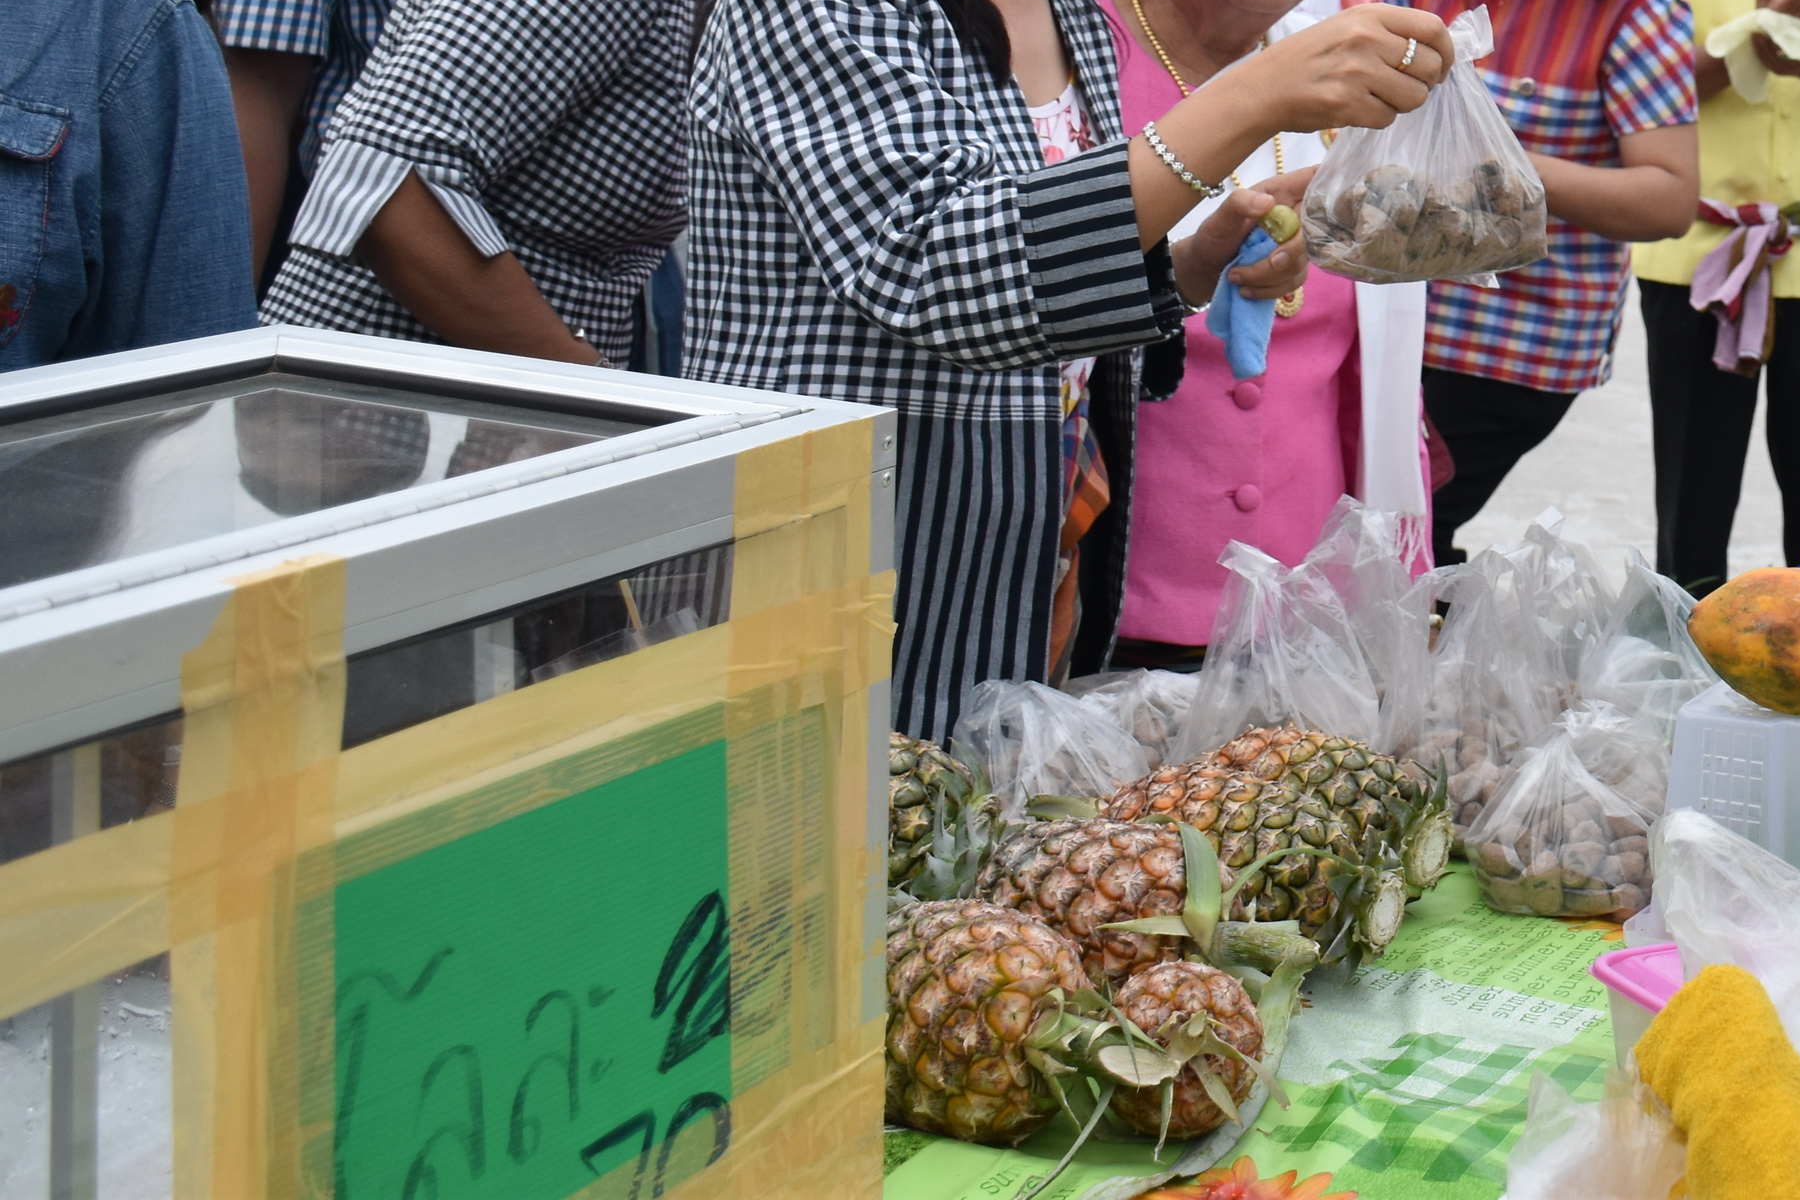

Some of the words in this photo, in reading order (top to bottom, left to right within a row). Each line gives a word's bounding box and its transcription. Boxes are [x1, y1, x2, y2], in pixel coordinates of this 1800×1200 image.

[1502, 942, 1563, 983] summer
[1441, 965, 1504, 1006] summer
[1491, 974, 1554, 1019] summer
